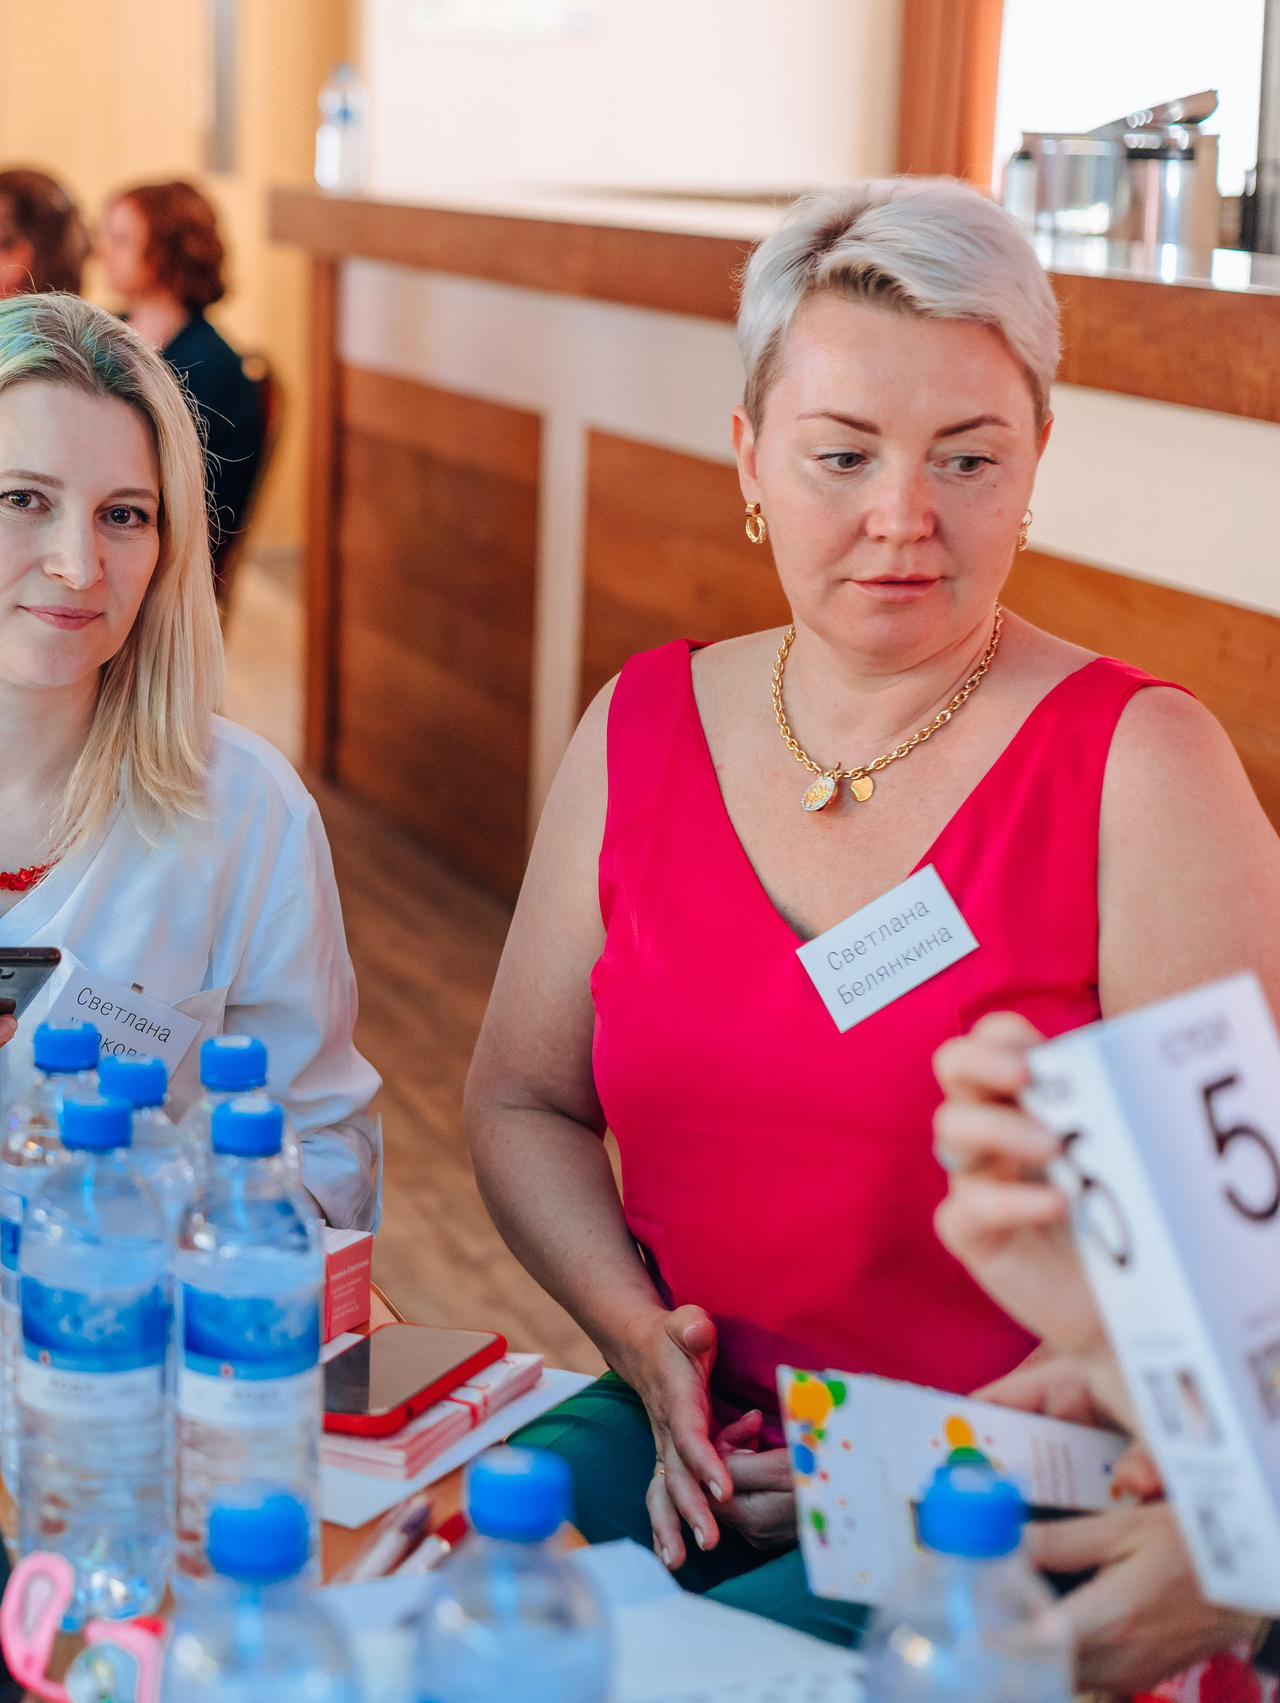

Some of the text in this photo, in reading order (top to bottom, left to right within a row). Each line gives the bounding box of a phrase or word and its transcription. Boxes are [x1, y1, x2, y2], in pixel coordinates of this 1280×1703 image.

[826, 900, 930, 971] Светлана
[836, 926, 954, 1006] Белянкина
[76, 987, 172, 1043] Светлана
[1201, 1071, 1280, 1225] 5
